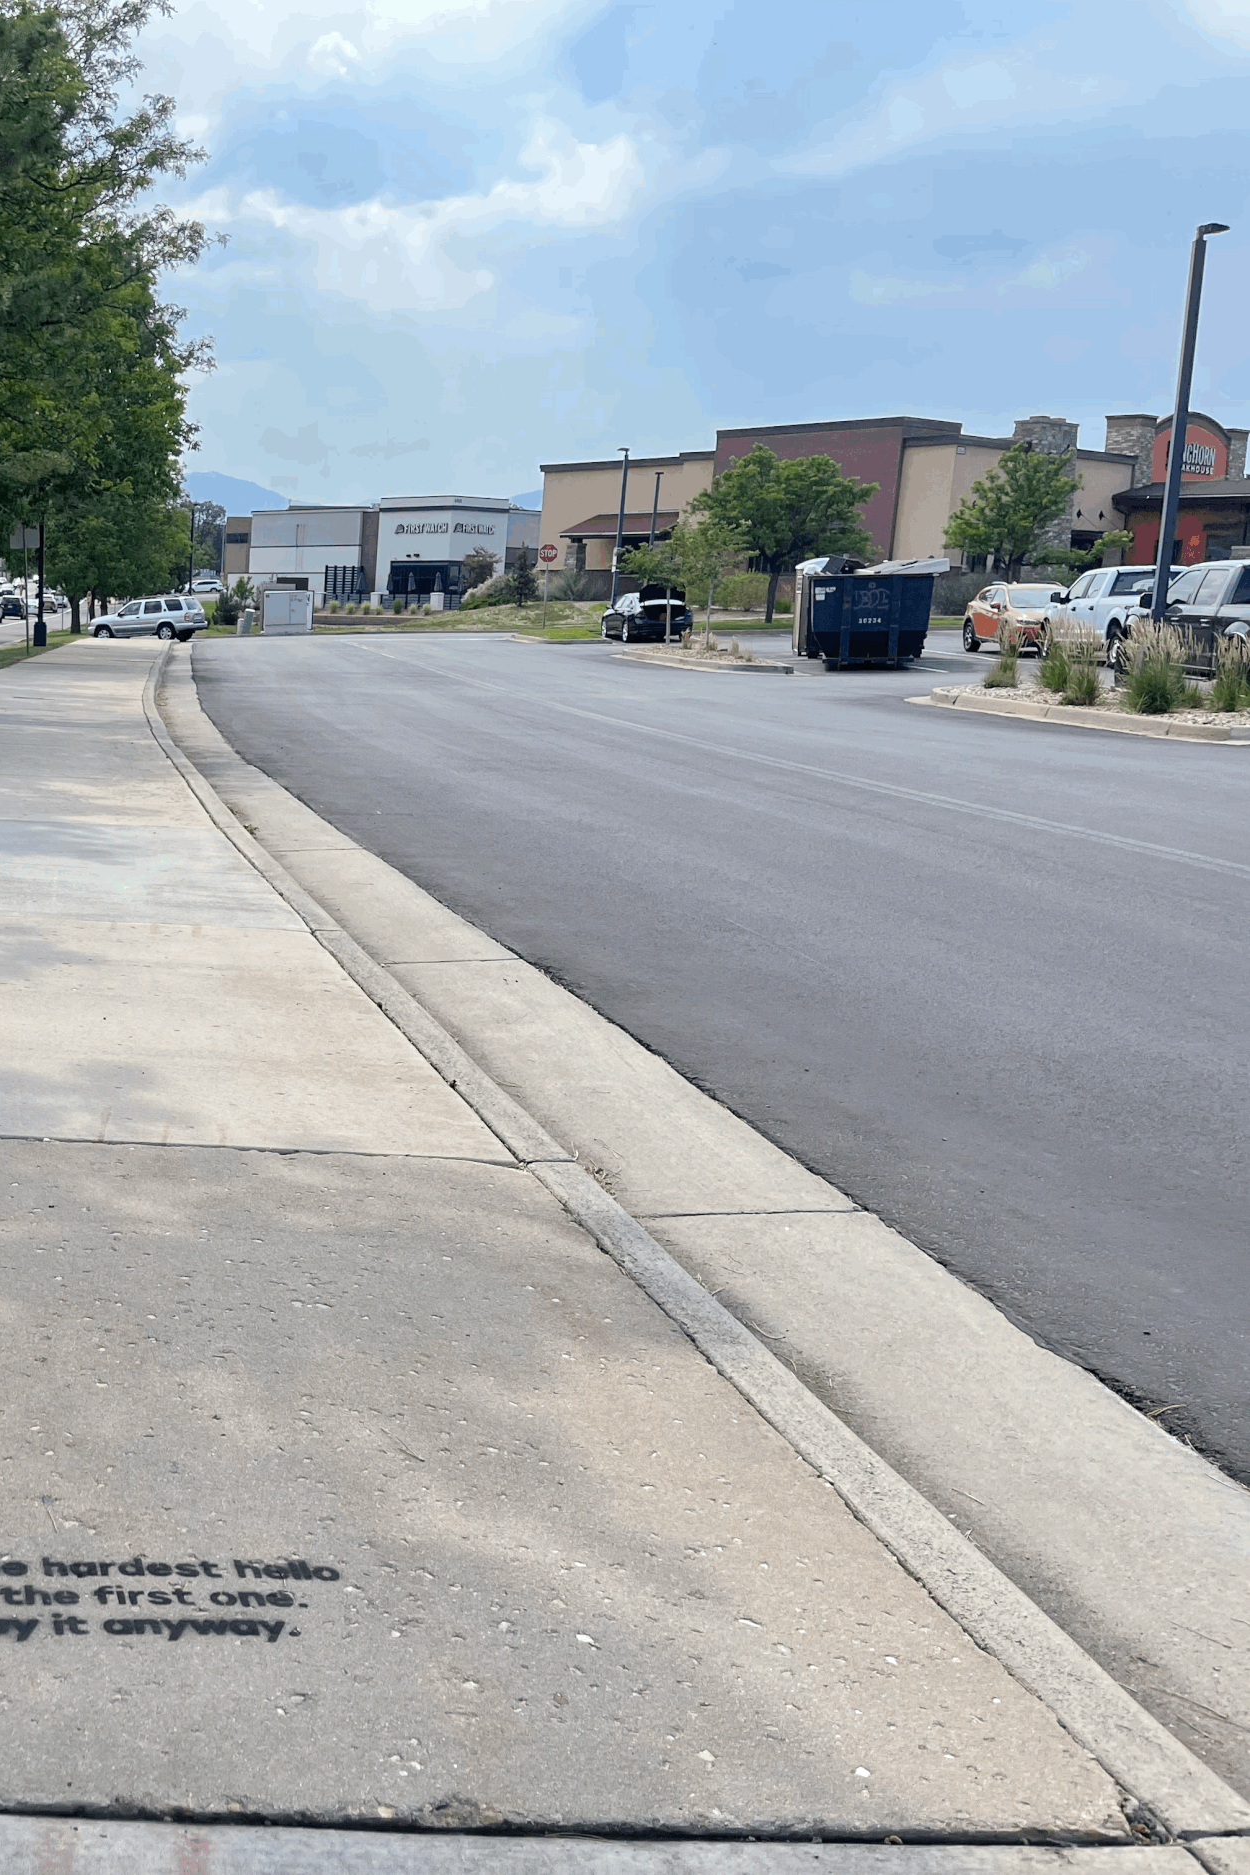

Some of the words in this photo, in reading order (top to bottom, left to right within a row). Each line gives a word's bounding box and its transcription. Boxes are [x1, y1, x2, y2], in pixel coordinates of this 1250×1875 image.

[1181, 464, 1214, 475] AKHOUSE
[404, 523, 424, 534] FIRST
[425, 523, 448, 533] WATCH
[463, 523, 478, 534] FIRST
[540, 549, 557, 557] STOP
[42, 1557, 222, 1578] hardest
[233, 1559, 340, 1581] hello
[93, 1585, 196, 1606] first
[209, 1589, 309, 1608] one.
[52, 1613, 90, 1636] it
[103, 1618, 302, 1643] anyway.
